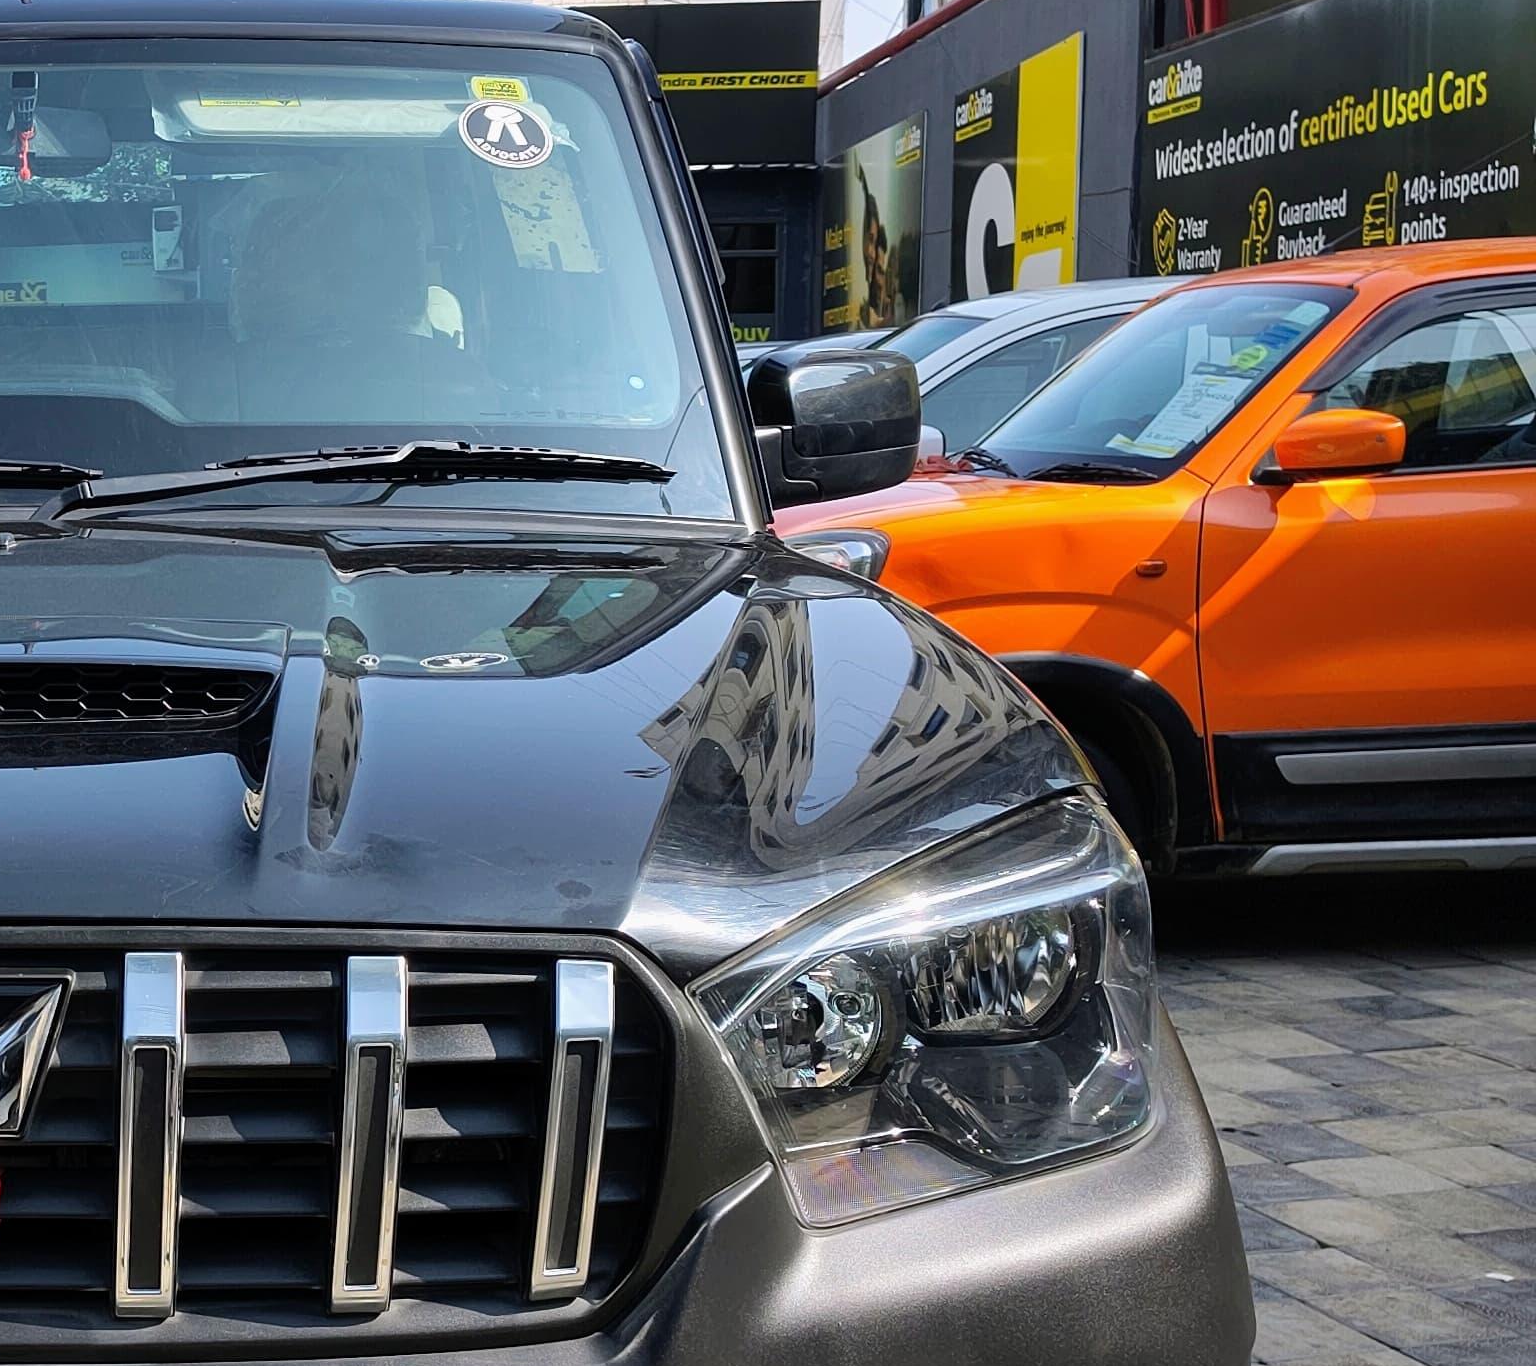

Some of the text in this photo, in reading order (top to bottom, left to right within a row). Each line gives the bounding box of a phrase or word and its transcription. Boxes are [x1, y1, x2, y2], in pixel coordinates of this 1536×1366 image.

[701, 76, 747, 86] FIRST
[749, 75, 806, 85] CHOICE
[1149, 59, 1202, 106] car&bike
[1156, 71, 1487, 180] Widest selection of certified Used Cars
[473, 137, 541, 161] ADVOCATE
[1402, 160, 1520, 207] 140+ inspection
[1278, 188, 1347, 227] Guaranteed
[1178, 217, 1209, 242] 2-Year
[1277, 227, 1326, 261] Buyback
[1400, 212, 1447, 245] points
[120, 248, 153, 260] car&
[1177, 244, 1222, 273] Warranty
[20, 281, 47, 303] &
